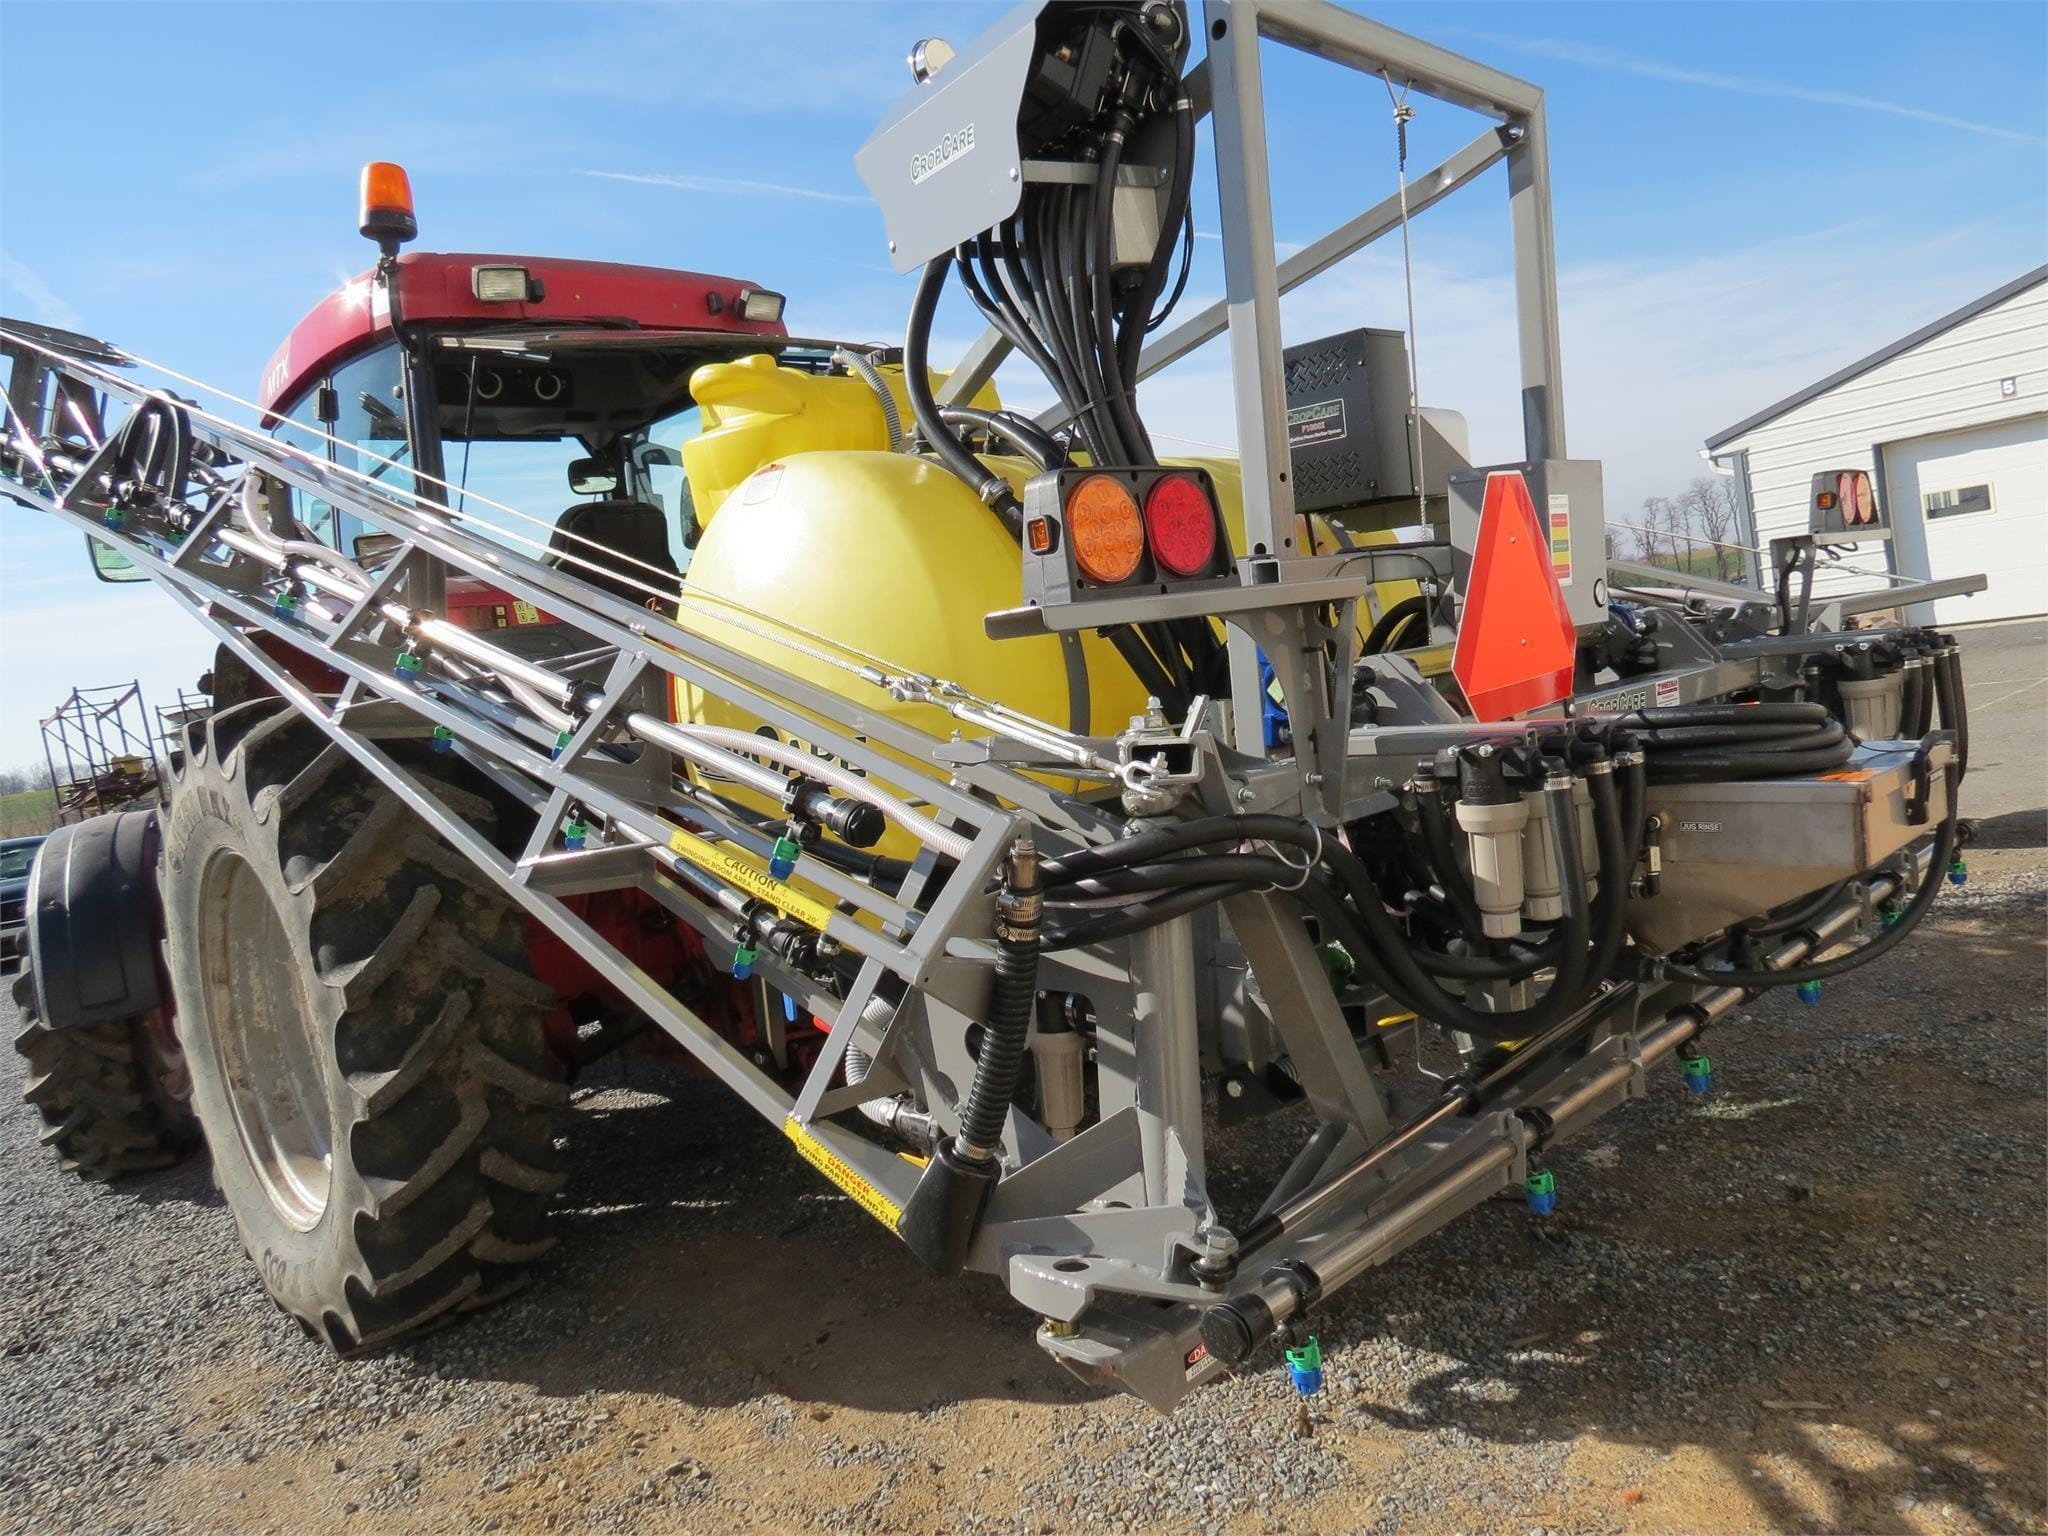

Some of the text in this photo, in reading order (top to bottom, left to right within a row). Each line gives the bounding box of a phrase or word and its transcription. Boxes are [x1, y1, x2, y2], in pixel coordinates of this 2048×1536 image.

[267, 354, 289, 400] MTX
[2003, 380, 2014, 394] 5
[677, 843, 711, 869] SWINGING
[711, 861, 733, 877] BOOM
[733, 873, 751, 887] AREA
[756, 886, 781, 904] STAND
[782, 901, 806, 919] CLEAR
[724, 857, 778, 891] CAUTION
[798, 1142, 895, 1224] OVING PARTS STAND CLE
[828, 1157, 870, 1193] DANGER
